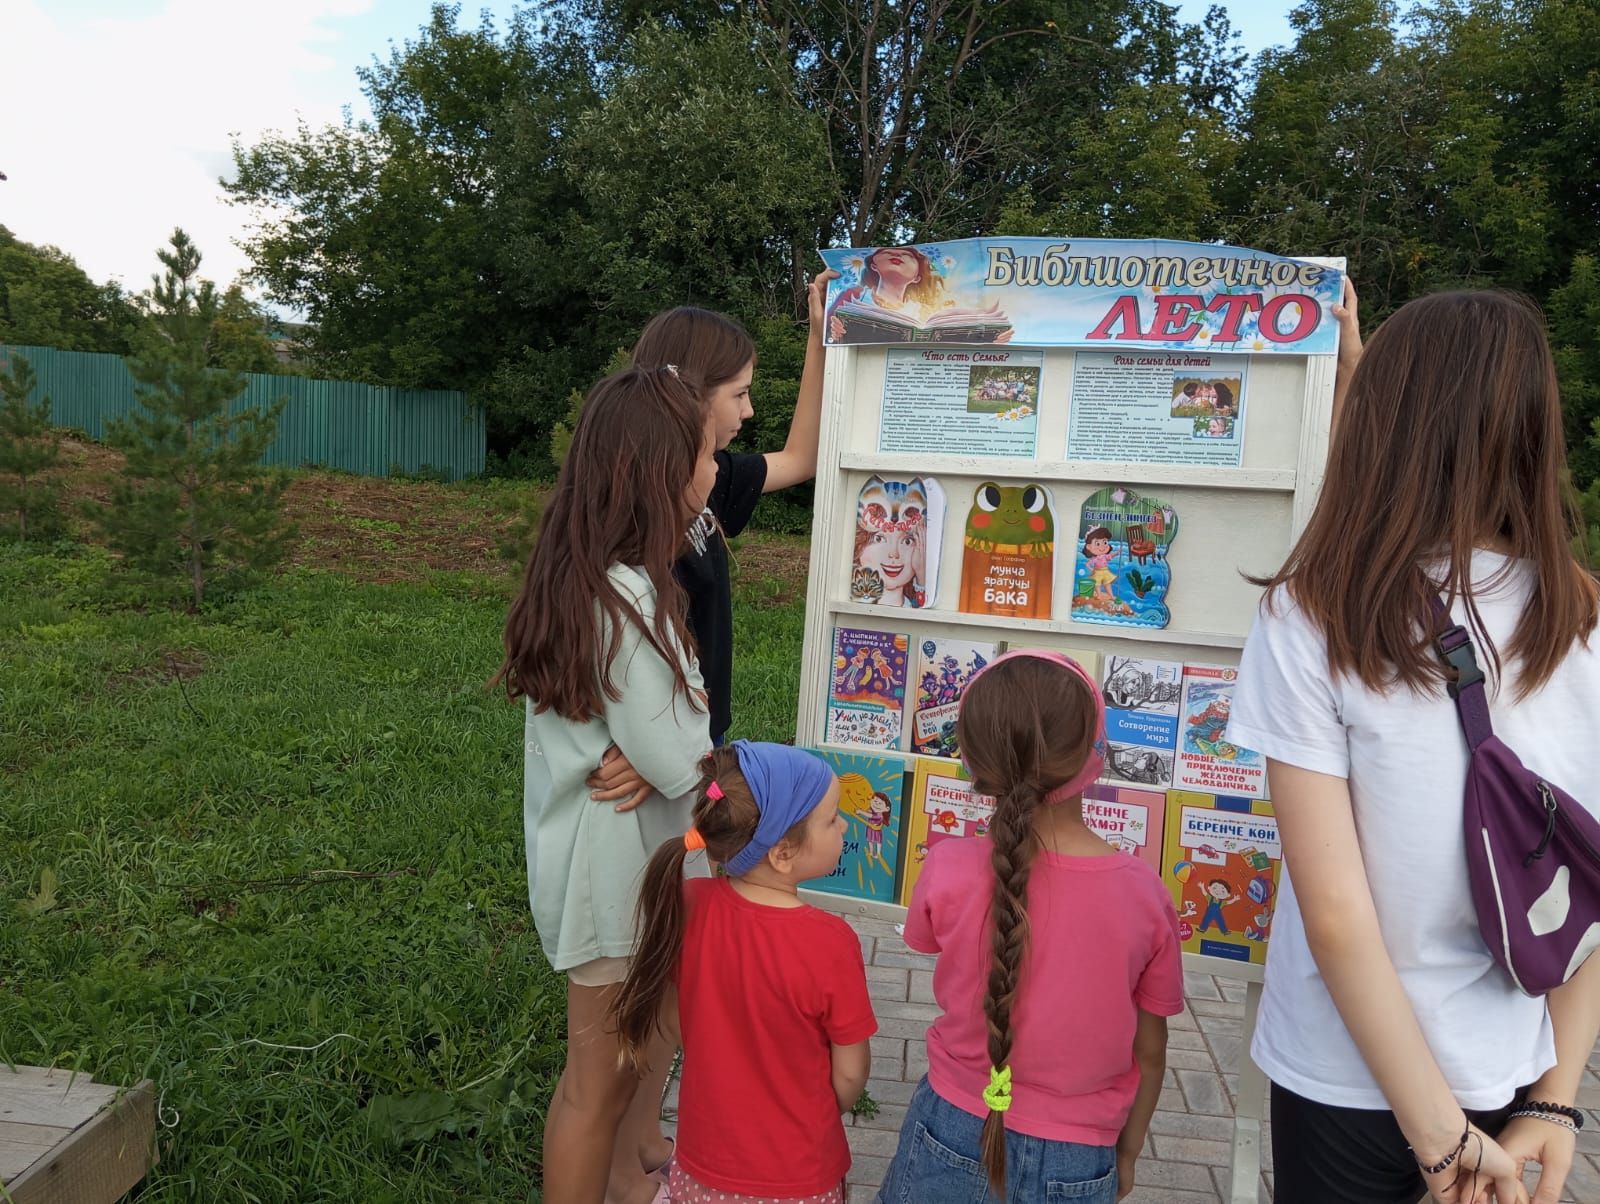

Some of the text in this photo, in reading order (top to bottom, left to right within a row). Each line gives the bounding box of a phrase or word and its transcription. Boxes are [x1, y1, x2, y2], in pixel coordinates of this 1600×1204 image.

[985, 243, 1325, 287] Библиотечное
[1086, 293, 1322, 343] ЛЕТО
[922, 350, 1010, 362] Что есть Семья?
[1114, 355, 1211, 367] Роль семьи для детей
[990, 565, 1025, 576] мунча
[984, 576, 1030, 589] яратучы
[984, 588, 1028, 606] бака
[1118, 719, 1170, 734] Сотворение
[1146, 734, 1169, 743] мира
[1181, 752, 1215, 763] НОВЫЕ
[1186, 762, 1261, 776] ПРИКЛЮЧЕНИЯ
[1182, 776, 1257, 792] ЧЕМОДАНЧИКА
[1188, 820, 1275, 840] БЕРЕНЧЕ КӨН
